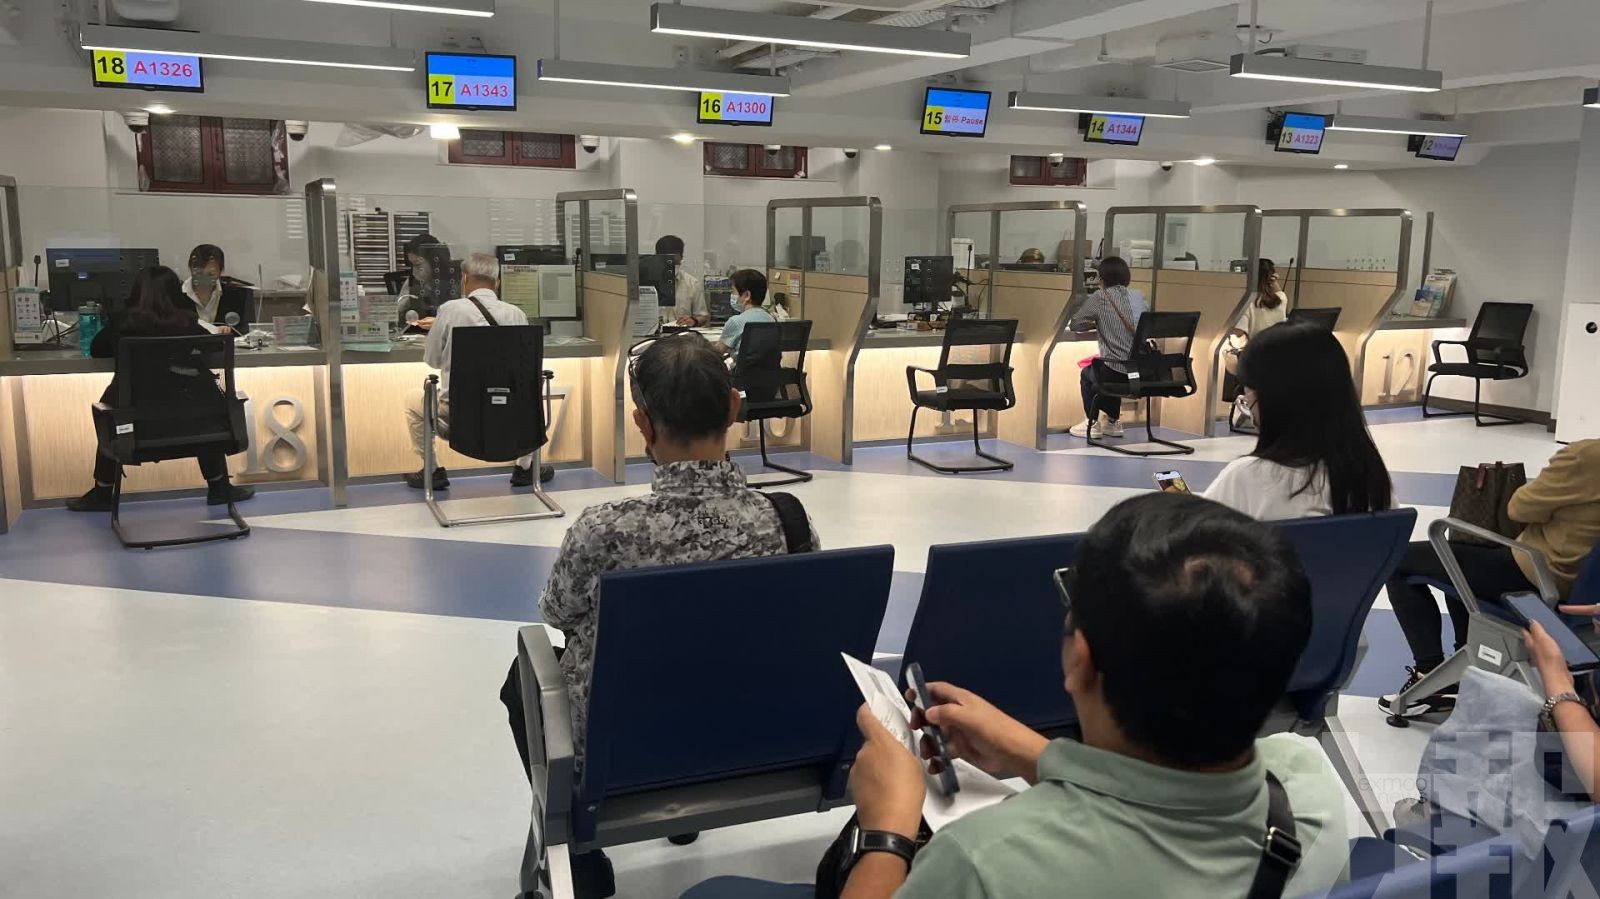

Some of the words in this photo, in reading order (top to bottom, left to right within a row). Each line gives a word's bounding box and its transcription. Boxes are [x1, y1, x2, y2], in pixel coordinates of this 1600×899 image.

[97, 56, 124, 75] 18
[134, 60, 192, 77] A1326
[431, 80, 453, 97] 17
[461, 84, 508, 97] A1343
[703, 98, 721, 113] 16
[726, 101, 766, 114] A1300
[926, 111, 943, 125] 15
[961, 116, 984, 126] Pause
[1091, 120, 1105, 133] 14
[1107, 123, 1137, 135] A1344
[1281, 131, 1293, 144] 13
